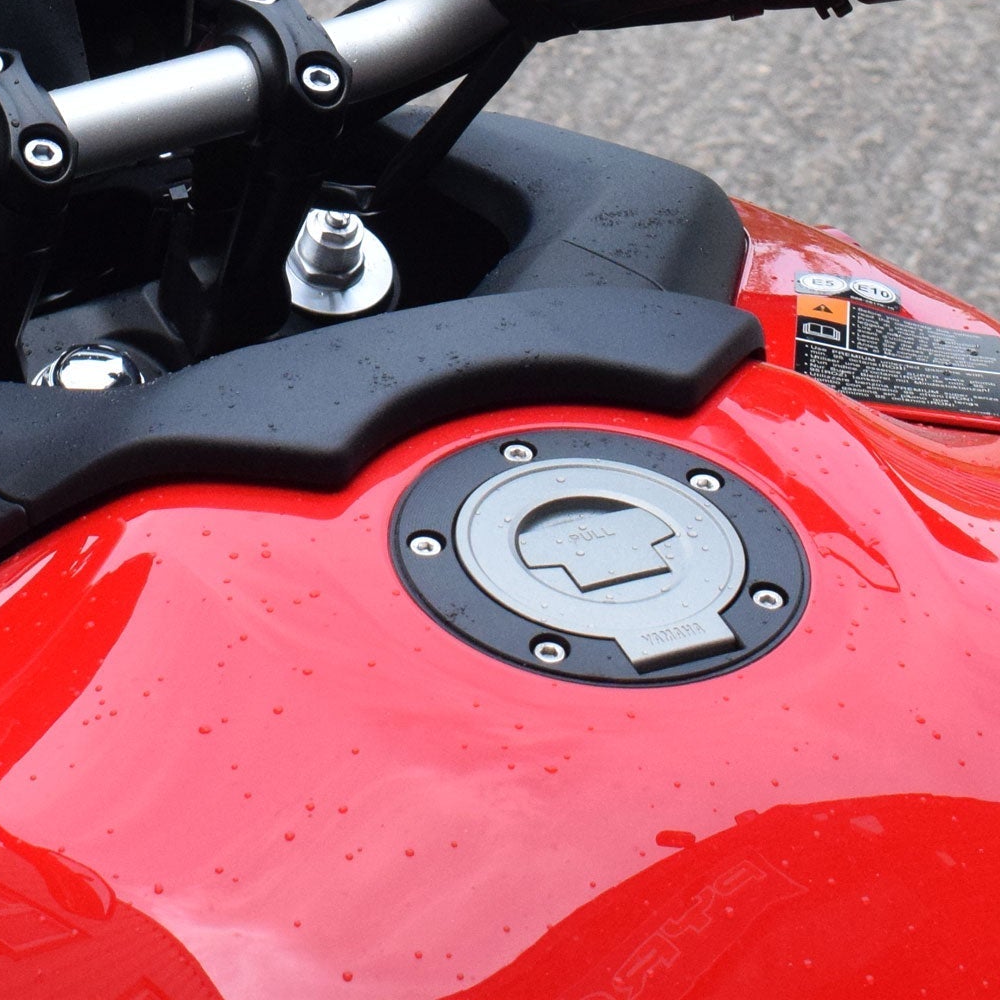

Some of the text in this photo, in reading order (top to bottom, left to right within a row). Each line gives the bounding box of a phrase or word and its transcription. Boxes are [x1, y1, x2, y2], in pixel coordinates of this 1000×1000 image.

[811, 277, 890, 299] E5 E10
[567, 527, 616, 544] PULL
[640, 621, 705, 647] YAMAHA
